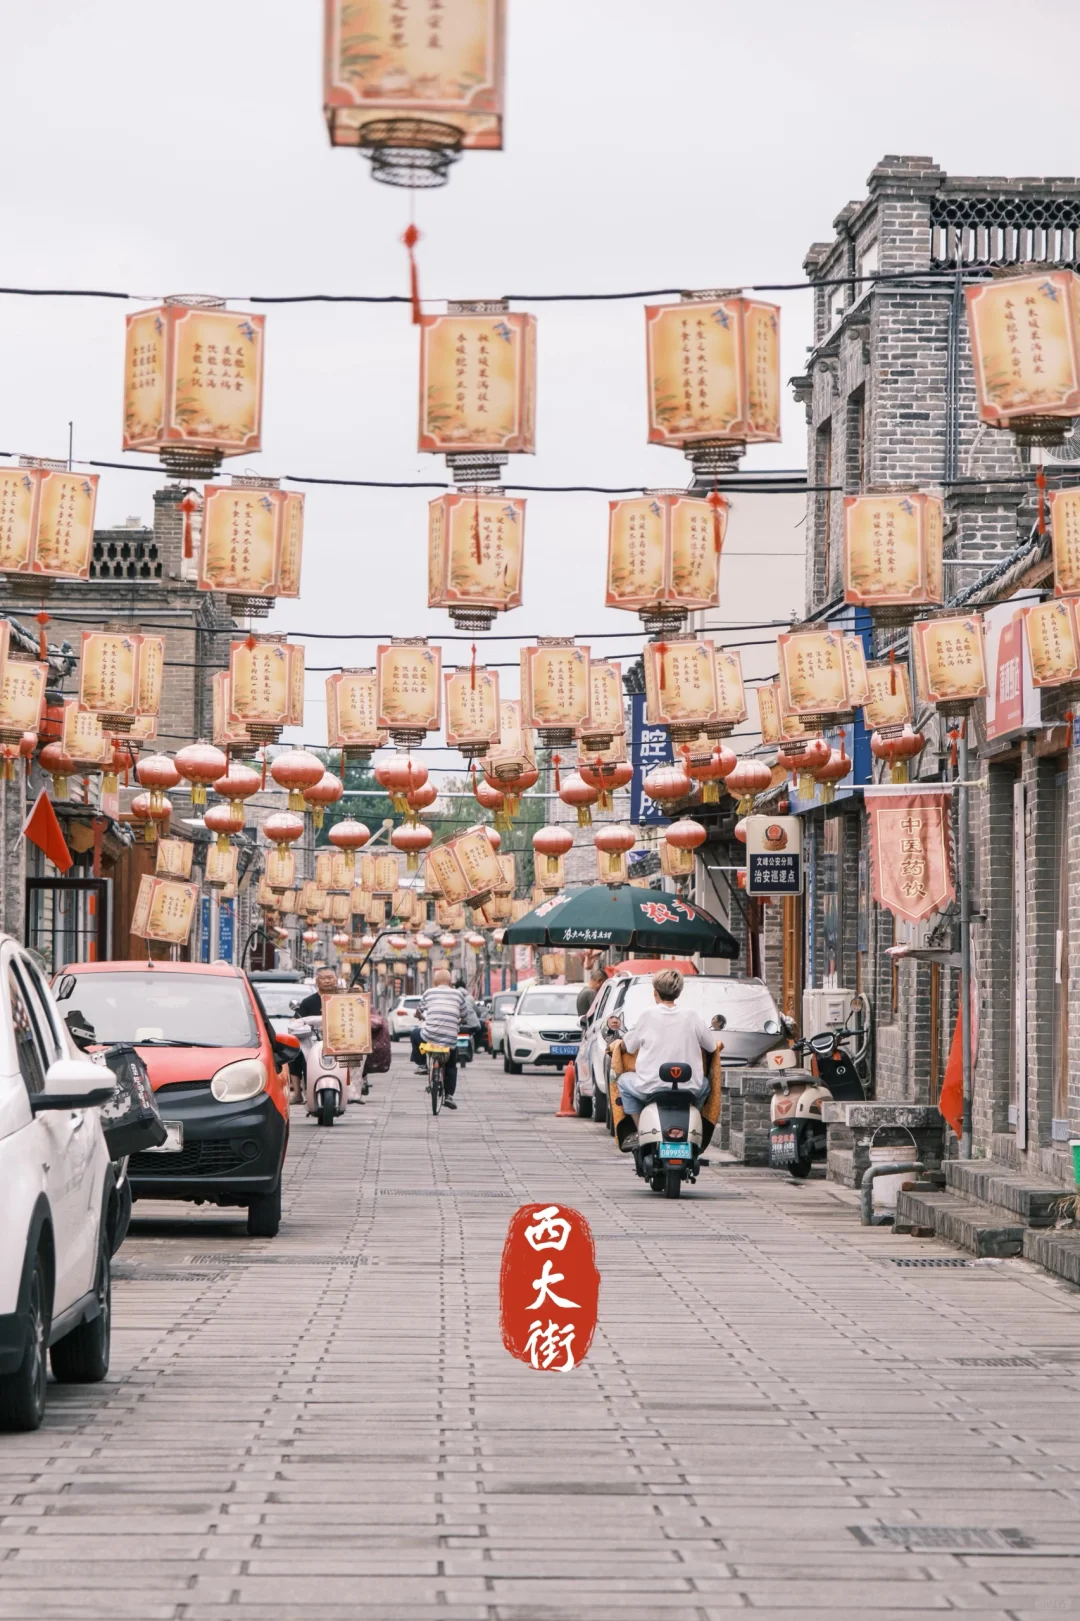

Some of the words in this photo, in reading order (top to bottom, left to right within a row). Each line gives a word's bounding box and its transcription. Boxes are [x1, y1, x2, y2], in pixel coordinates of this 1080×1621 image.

[756, 856, 793, 867] 文峰公安分局
[900, 817, 927, 897] 中医药饮
[754, 869, 795, 883] 治安巡逻点
[562, 927, 613, 941] 农夫山泉有点甜
